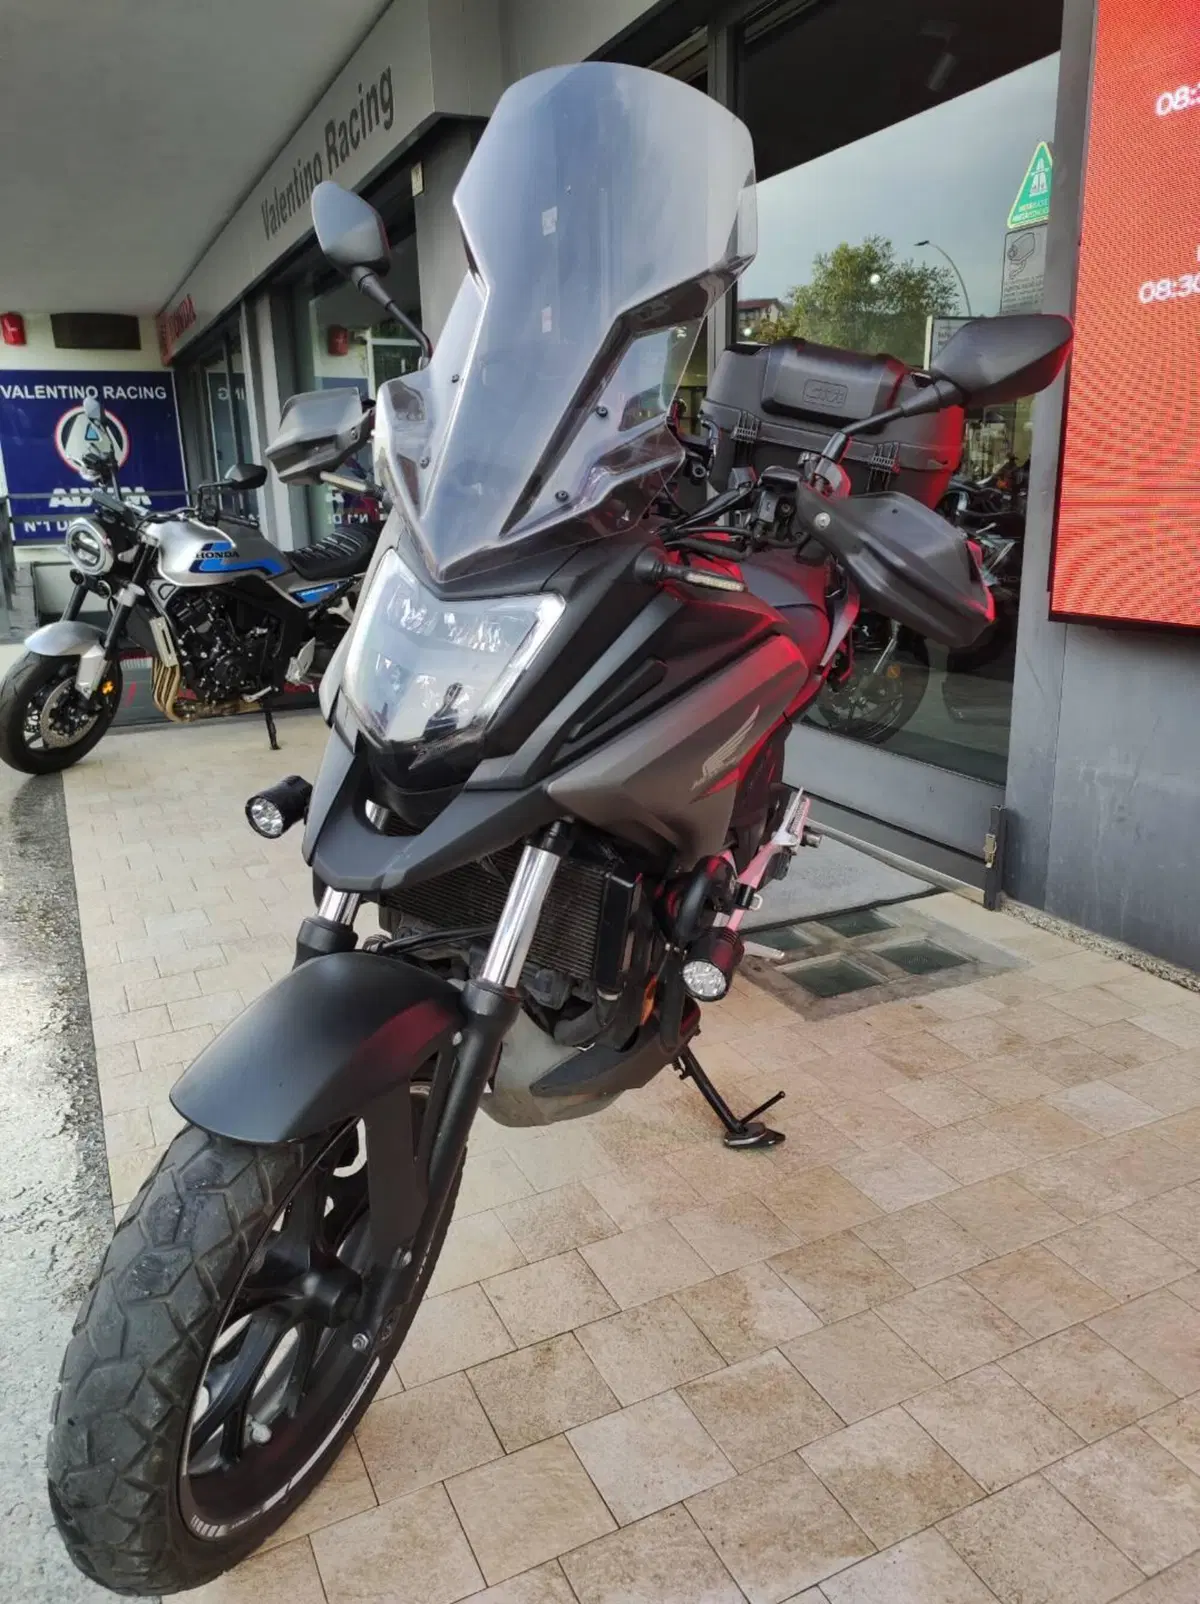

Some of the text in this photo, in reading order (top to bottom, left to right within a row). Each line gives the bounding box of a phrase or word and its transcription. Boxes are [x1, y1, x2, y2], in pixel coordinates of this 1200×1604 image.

[261, 64, 394, 241] Valentino Racing
[0, 384, 167, 400] VALENTINO RACING
[195, 550, 241, 560] HONDA
